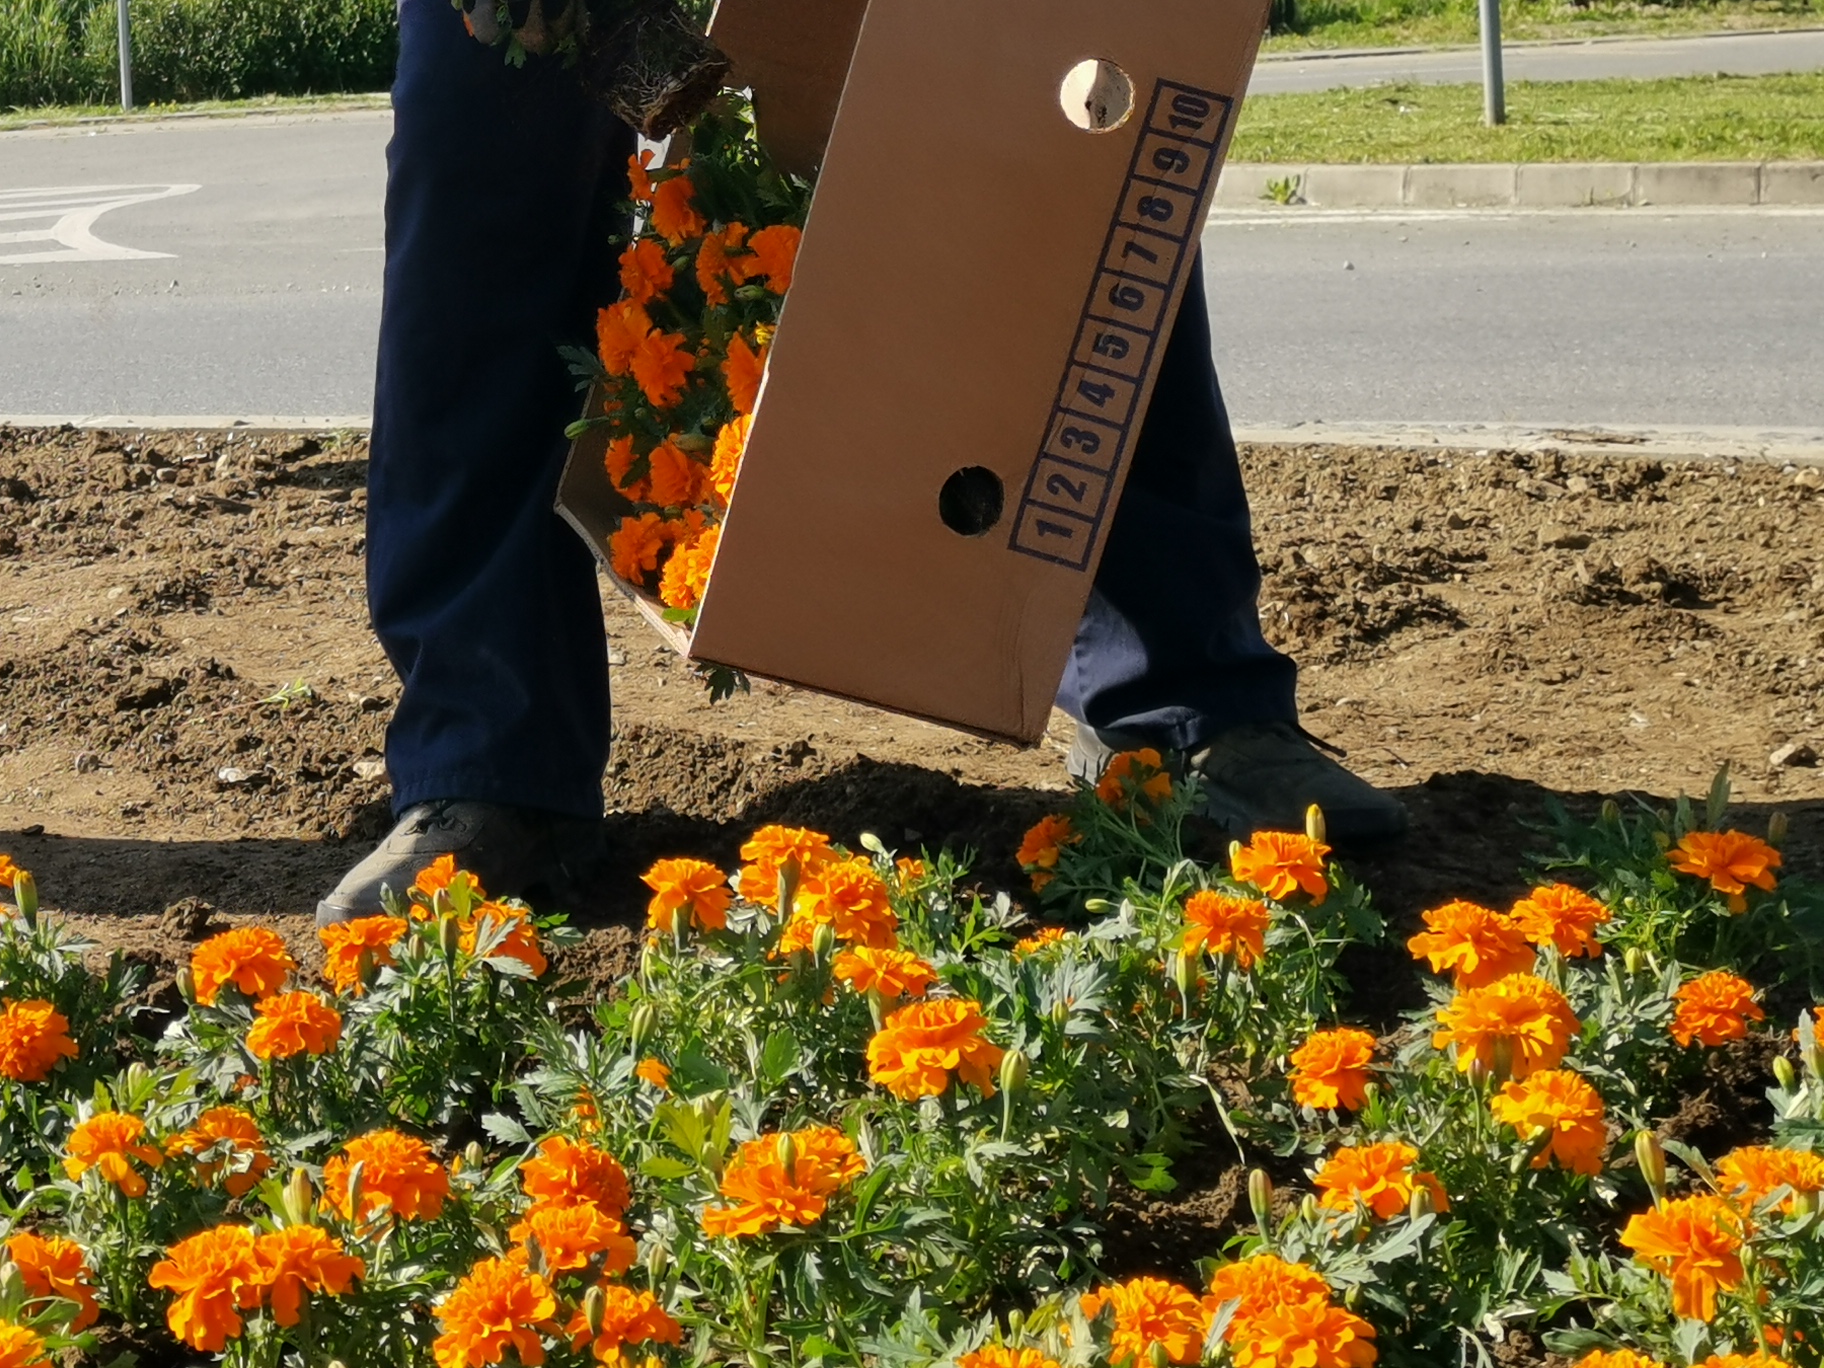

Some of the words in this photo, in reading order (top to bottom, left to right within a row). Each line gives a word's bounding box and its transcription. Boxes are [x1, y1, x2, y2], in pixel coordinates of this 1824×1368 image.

[1168, 94, 1210, 130] 10
[1152, 147, 1190, 174] 9
[1137, 196, 1174, 223] 8
[1121, 241, 1158, 266] 7
[1109, 283, 1146, 313] 6
[1093, 333, 1130, 361] 5
[1077, 379, 1115, 410] 4
[1060, 426, 1101, 456] 3
[1046, 473, 1087, 503] 2
[1036, 518, 1073, 538] 1
